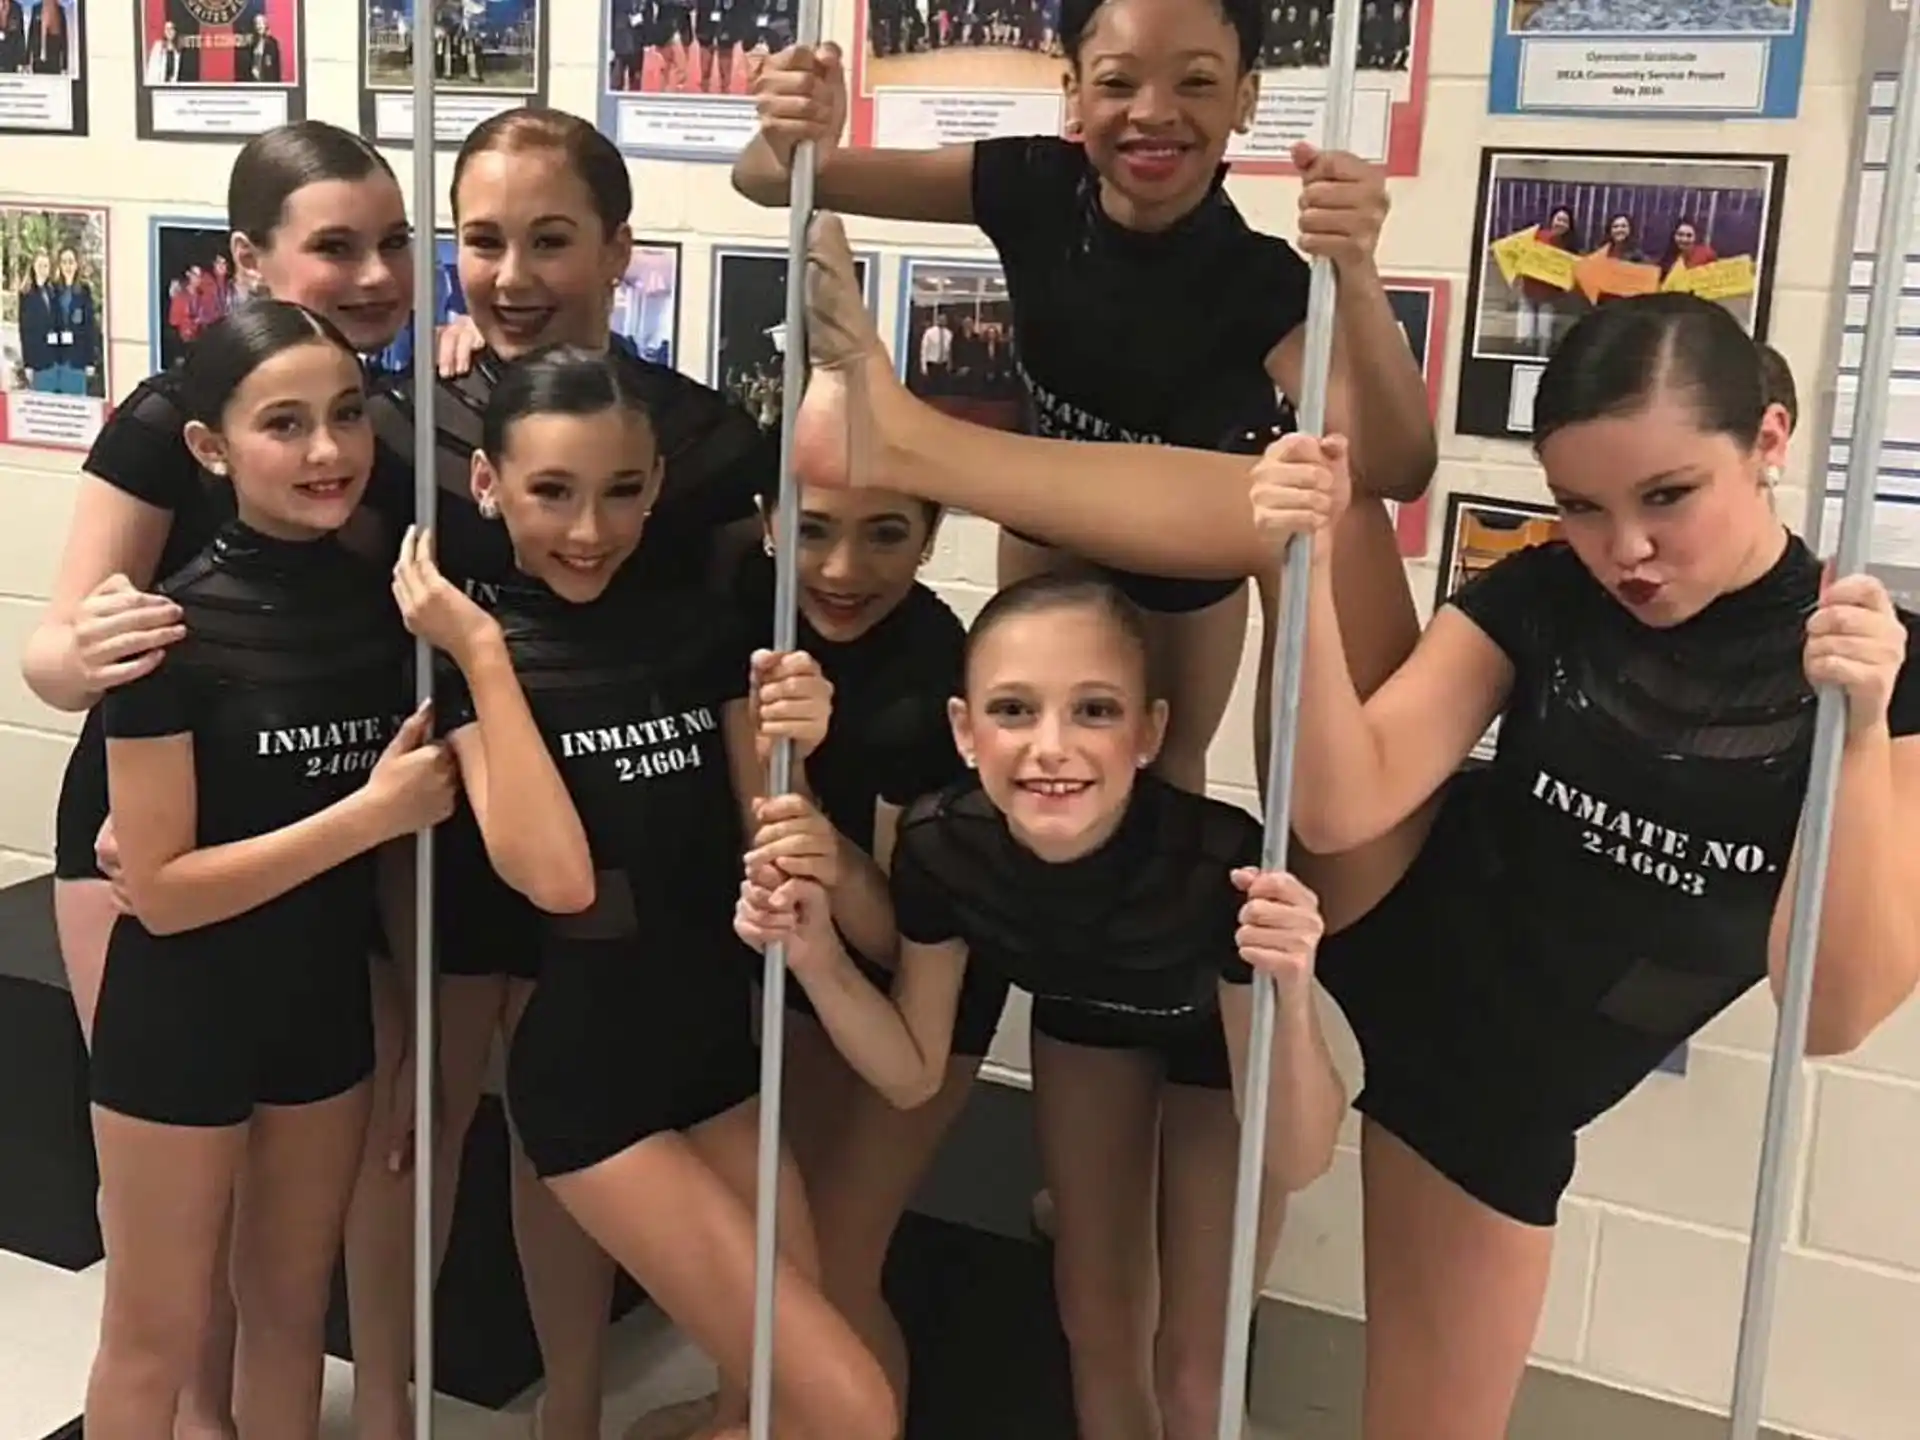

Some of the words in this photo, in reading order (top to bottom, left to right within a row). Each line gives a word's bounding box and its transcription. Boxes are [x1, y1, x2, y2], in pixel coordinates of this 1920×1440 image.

[1557, 69, 1583, 80] DECA
[1587, 70, 1645, 81] Community
[1648, 70, 1684, 80] Service
[1687, 70, 1725, 82] Project
[1586, 52, 1641, 63] Operation
[1644, 52, 1697, 62] Gratitude
[1612, 86, 1635, 96] May
[257, 716, 382, 755] INMATE
[560, 716, 680, 757] INMATE
[305, 750, 378, 777] 2460
[615, 743, 702, 782] 24604
[1531, 770, 1690, 858] INMATE
[1701, 839, 1777, 873] NO.
[1581, 829, 1708, 896] 24603
